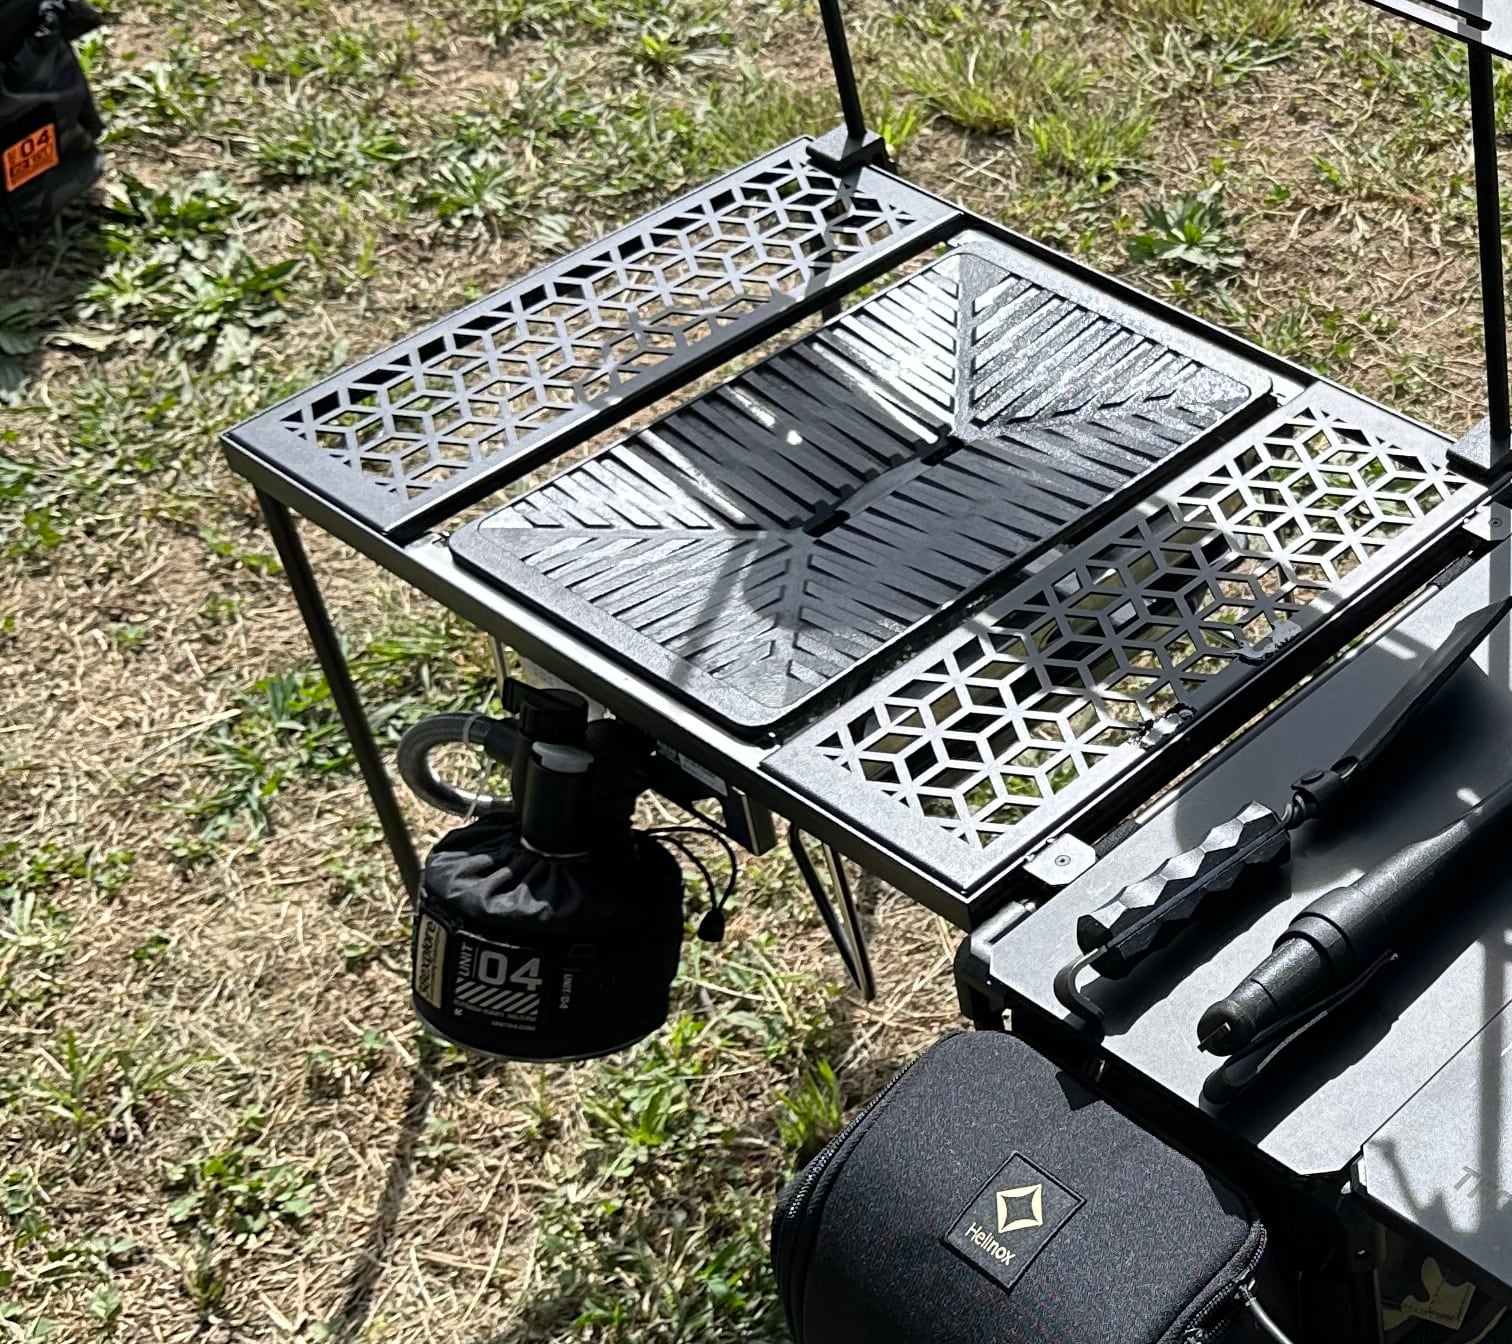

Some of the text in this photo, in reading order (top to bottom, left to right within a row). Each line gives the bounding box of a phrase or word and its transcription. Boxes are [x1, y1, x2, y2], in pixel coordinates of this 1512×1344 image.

[20, 129, 49, 159] 04
[458, 942, 475, 981] UNIT
[478, 950, 543, 991] 04
[964, 1222, 1016, 1266] Helinox
